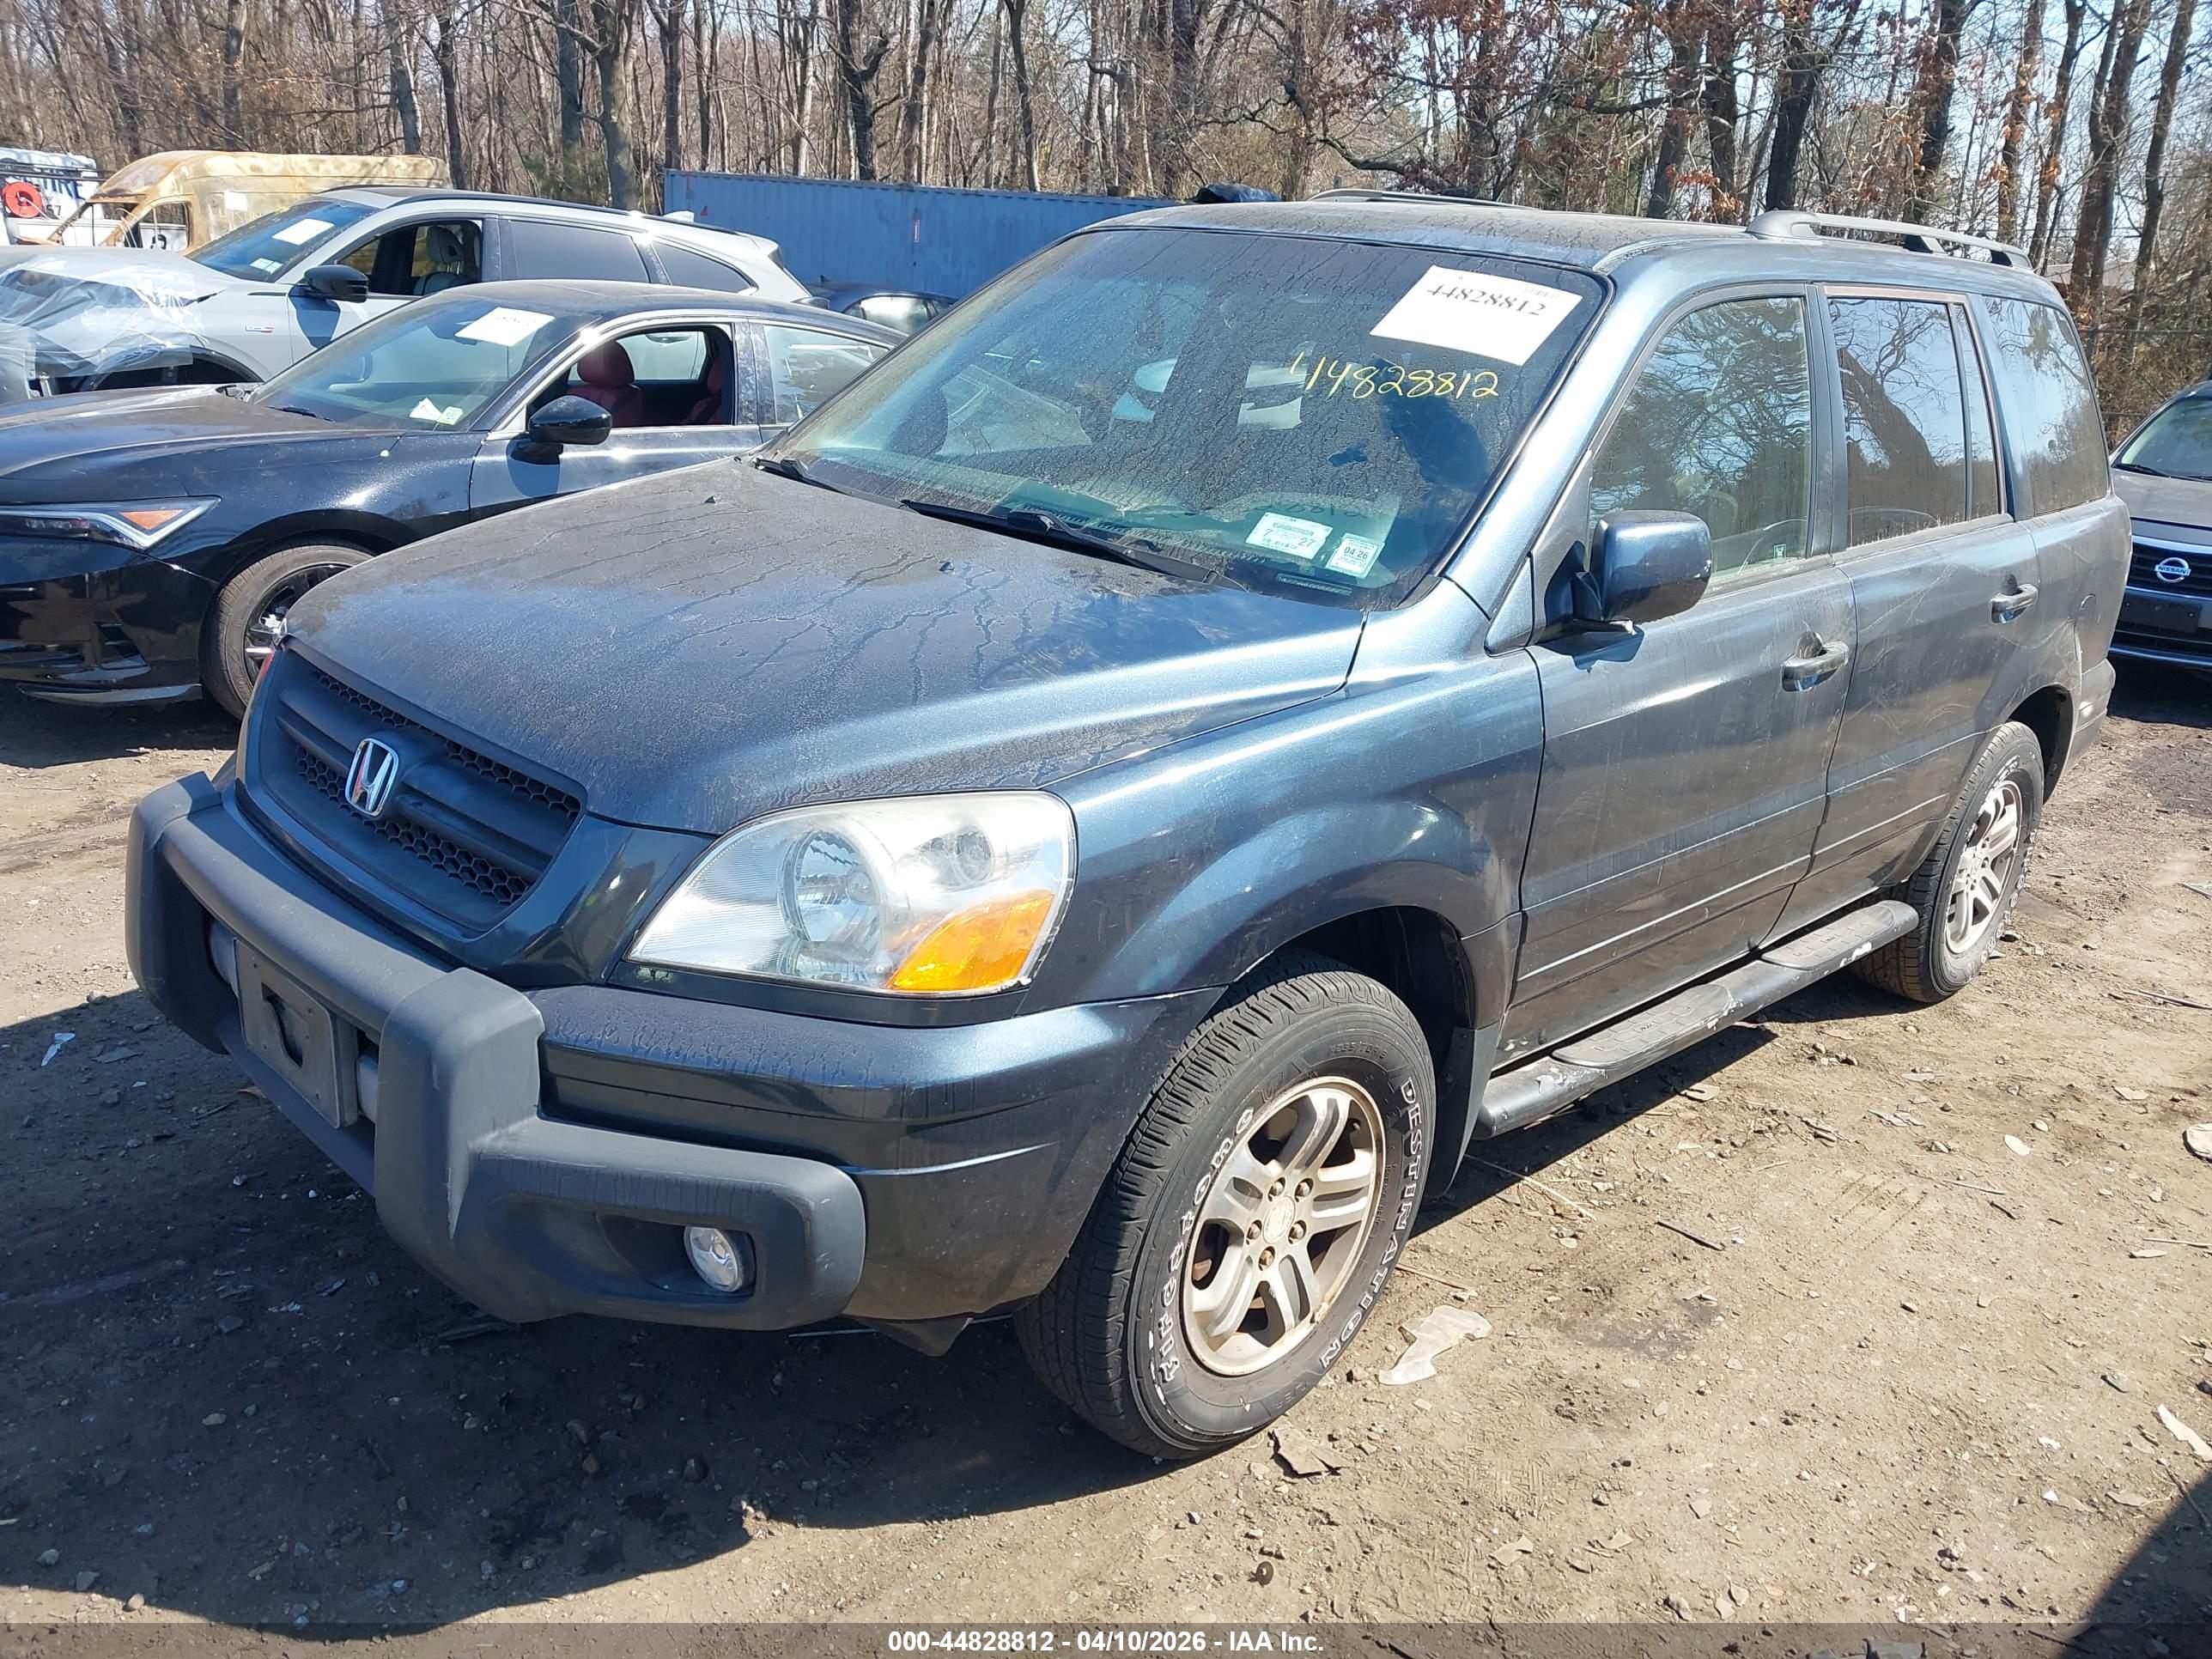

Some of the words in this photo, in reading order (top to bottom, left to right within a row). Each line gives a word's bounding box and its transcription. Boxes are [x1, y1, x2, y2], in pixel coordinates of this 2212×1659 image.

[1427, 283, 1547, 316] 44828812
[1290, 351, 1499, 401] 44828812
[2157, 565, 2187, 574] NISSAN
[1320, 1076, 1421, 1370] DESTINATION
